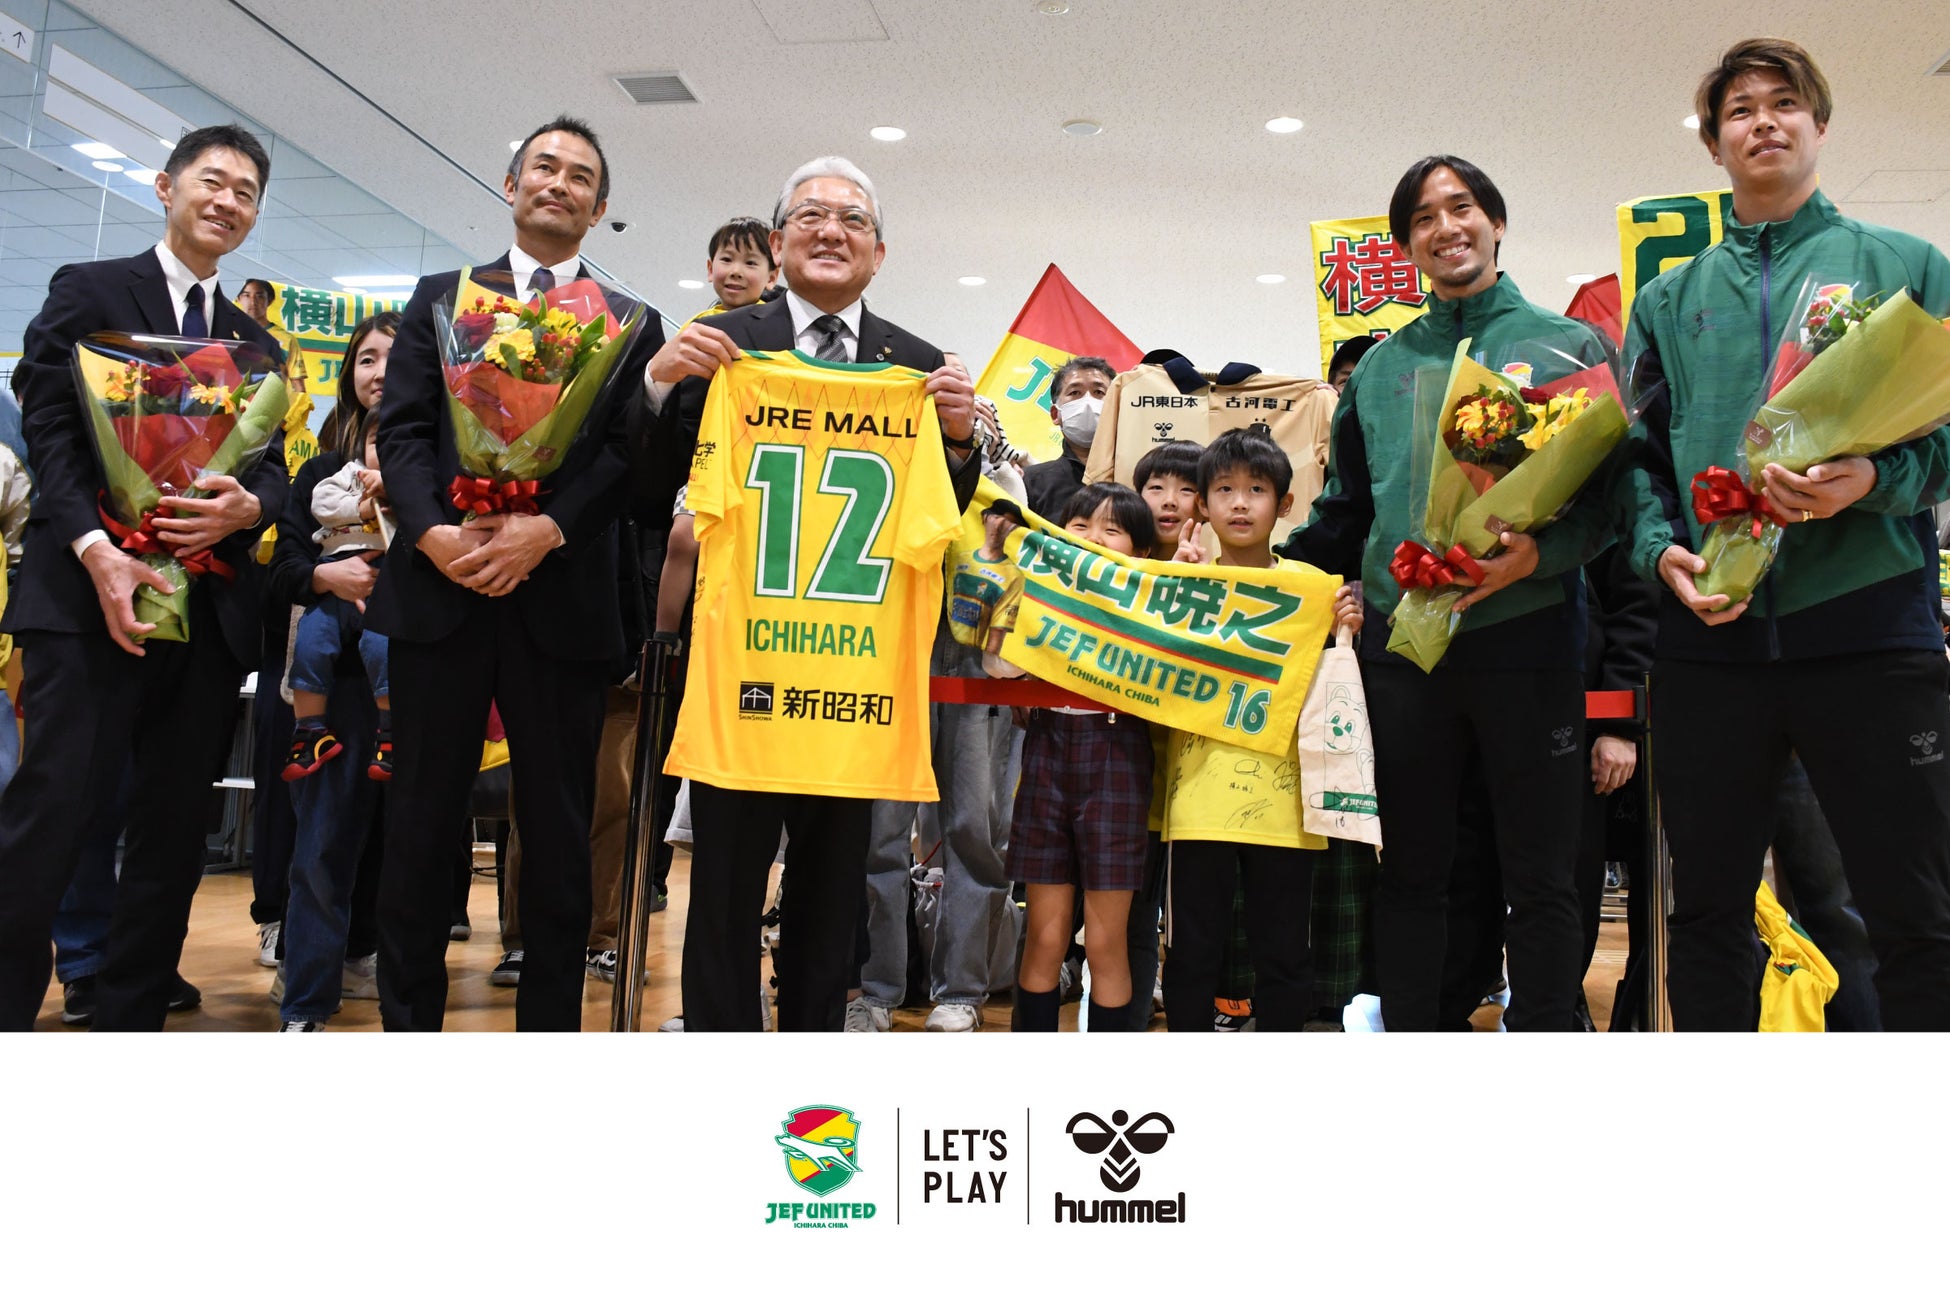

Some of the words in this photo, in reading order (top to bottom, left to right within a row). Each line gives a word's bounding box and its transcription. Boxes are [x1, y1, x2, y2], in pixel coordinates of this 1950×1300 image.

[1632, 196, 1733, 297] 2
[1319, 231, 1429, 352] 横
[745, 405, 812, 431] JRE
[1131, 395, 1198, 408] JR東日本
[1226, 396, 1297, 412] 古河電工
[824, 411, 919, 439] MALL
[744, 442, 895, 604] 12
[746, 618, 877, 658] ICHIHARA
[1024, 615, 1099, 662] JEF
[1096, 642, 1220, 703] UNITED
[1223, 681, 1272, 735] 16
[1067, 664, 1121, 695] ICHIHARA
[1124, 688, 1160, 708] CHIBA
[782, 686, 894, 726] 新昭和
